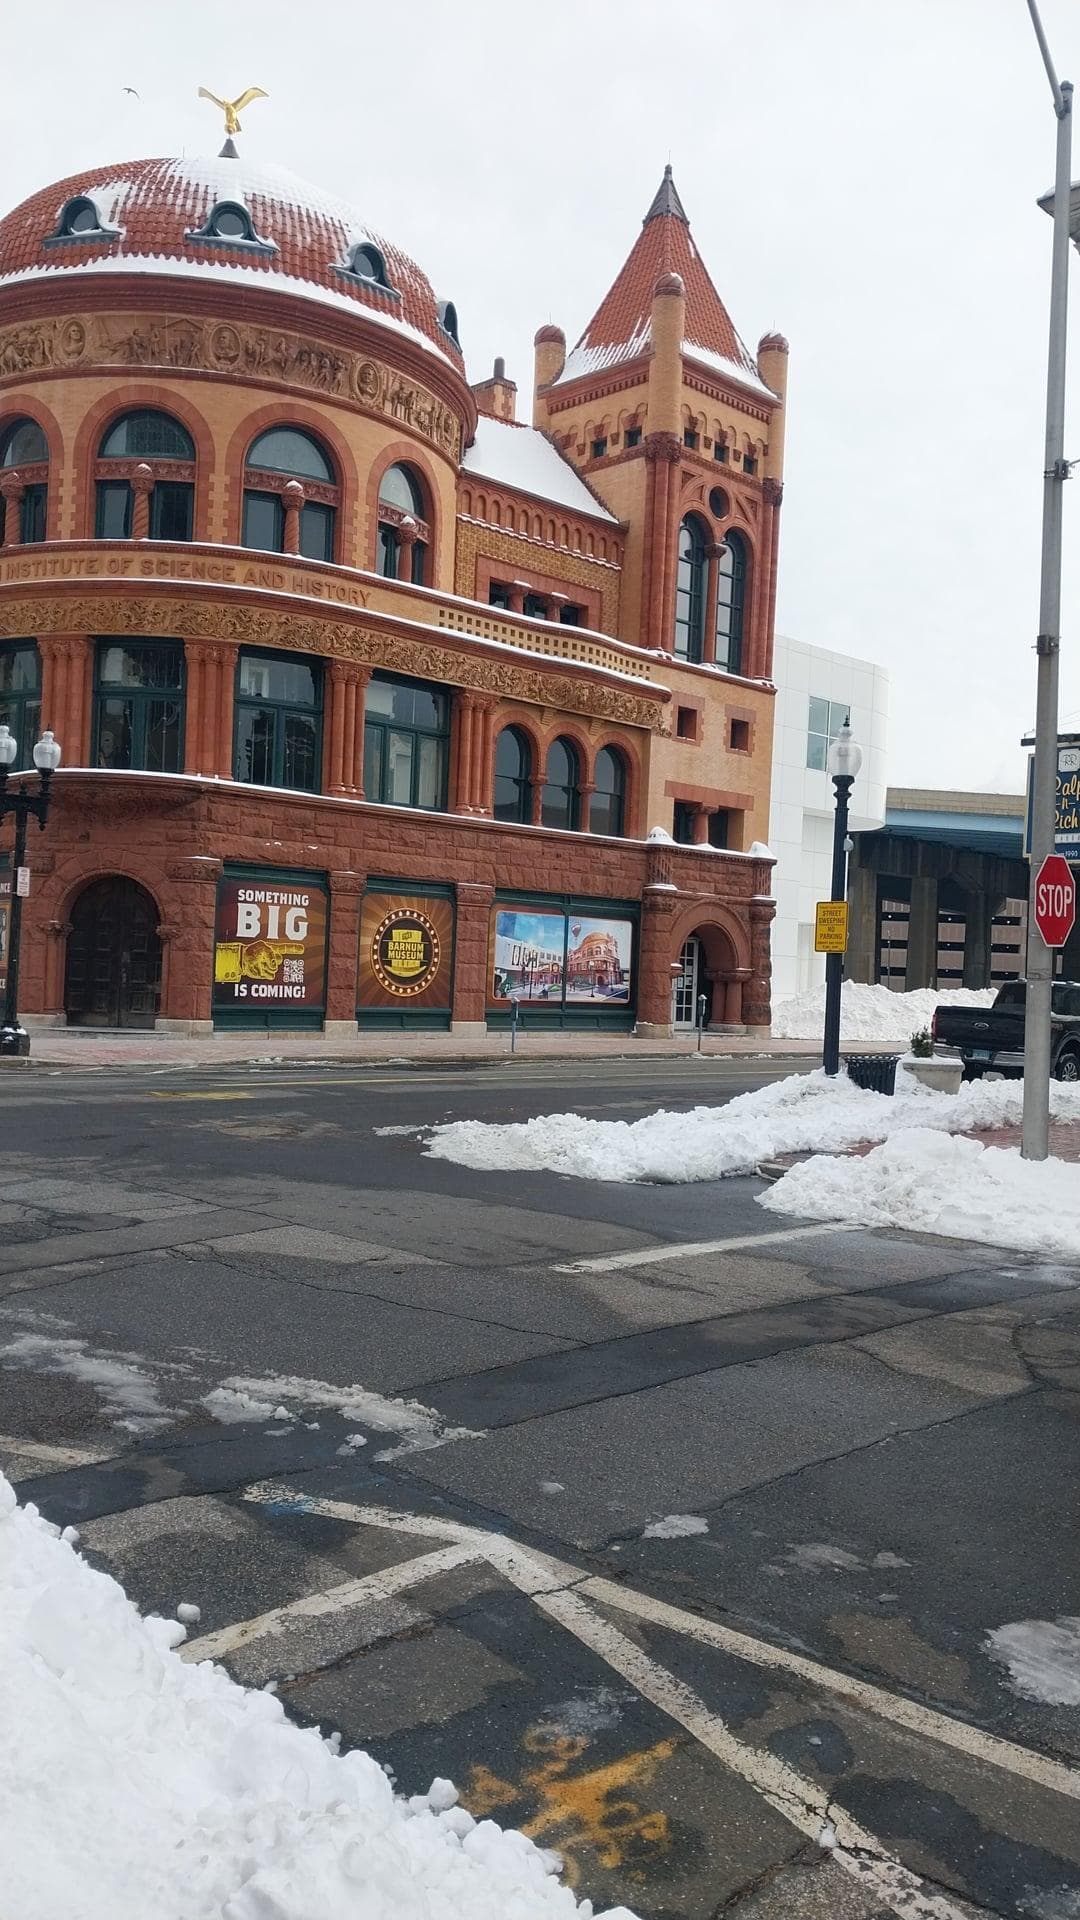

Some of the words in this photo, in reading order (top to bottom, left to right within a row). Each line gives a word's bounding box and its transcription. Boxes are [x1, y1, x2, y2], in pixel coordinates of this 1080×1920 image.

[6, 558, 99, 578] INSTITUTE
[107, 557, 132, 576] OF
[140, 558, 236, 582] SCIENCE
[243, 567, 285, 589] AND
[293, 575, 372, 607] HISTORY
[238, 888, 309, 906] SOMETHING
[1038, 884, 1073, 918] STOP
[237, 902, 309, 941] BIG
[388, 941, 425, 952] BARNUM
[388, 950, 425, 960] MUSEUM
[234, 984, 248, 997] IS
[251, 984, 306, 998] COMING!
